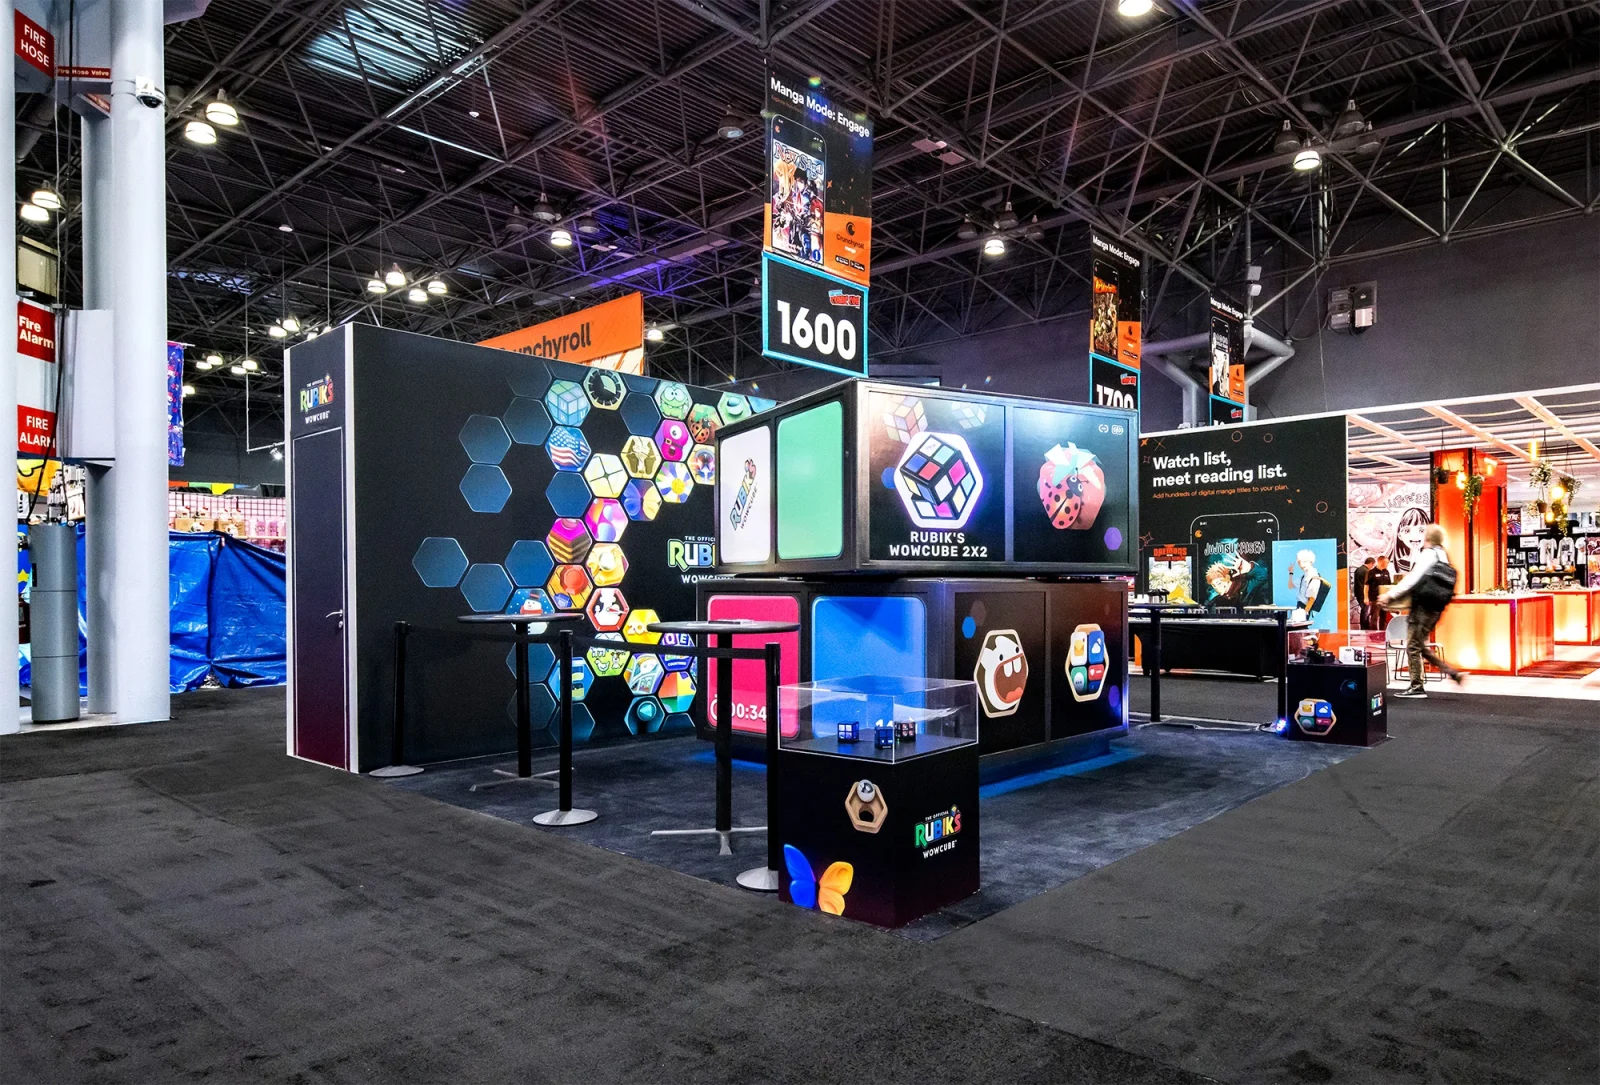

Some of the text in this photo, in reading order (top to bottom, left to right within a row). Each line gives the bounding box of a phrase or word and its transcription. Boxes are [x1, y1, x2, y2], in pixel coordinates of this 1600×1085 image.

[24, 24, 46, 48] FIRE
[21, 39, 49, 67] HOSE
[771, 77, 804, 105] Manga
[806, 95, 836, 121] Mode:
[837, 112, 870, 137] Engage
[18, 315, 41, 333] Fire
[777, 299, 857, 361] 1600
[19, 329, 54, 350] Alarm
[1096, 383, 1134, 409] 1700
[26, 415, 49, 431] FIRE
[19, 431, 56, 449] ALARM
[1153, 451, 1231, 470] Watch list,
[1153, 463, 1287, 487] meet reading list.
[1198, 488, 1215, 497] digital
[1216, 488, 1236, 496] manga
[1260, 485, 1273, 493] your
[910, 531, 965, 544] RUBIK'S
[668, 539, 716, 572] RUBI
[889, 544, 988, 558] WOWCUBE 2X2
[626, 621, 648, 635] 20
